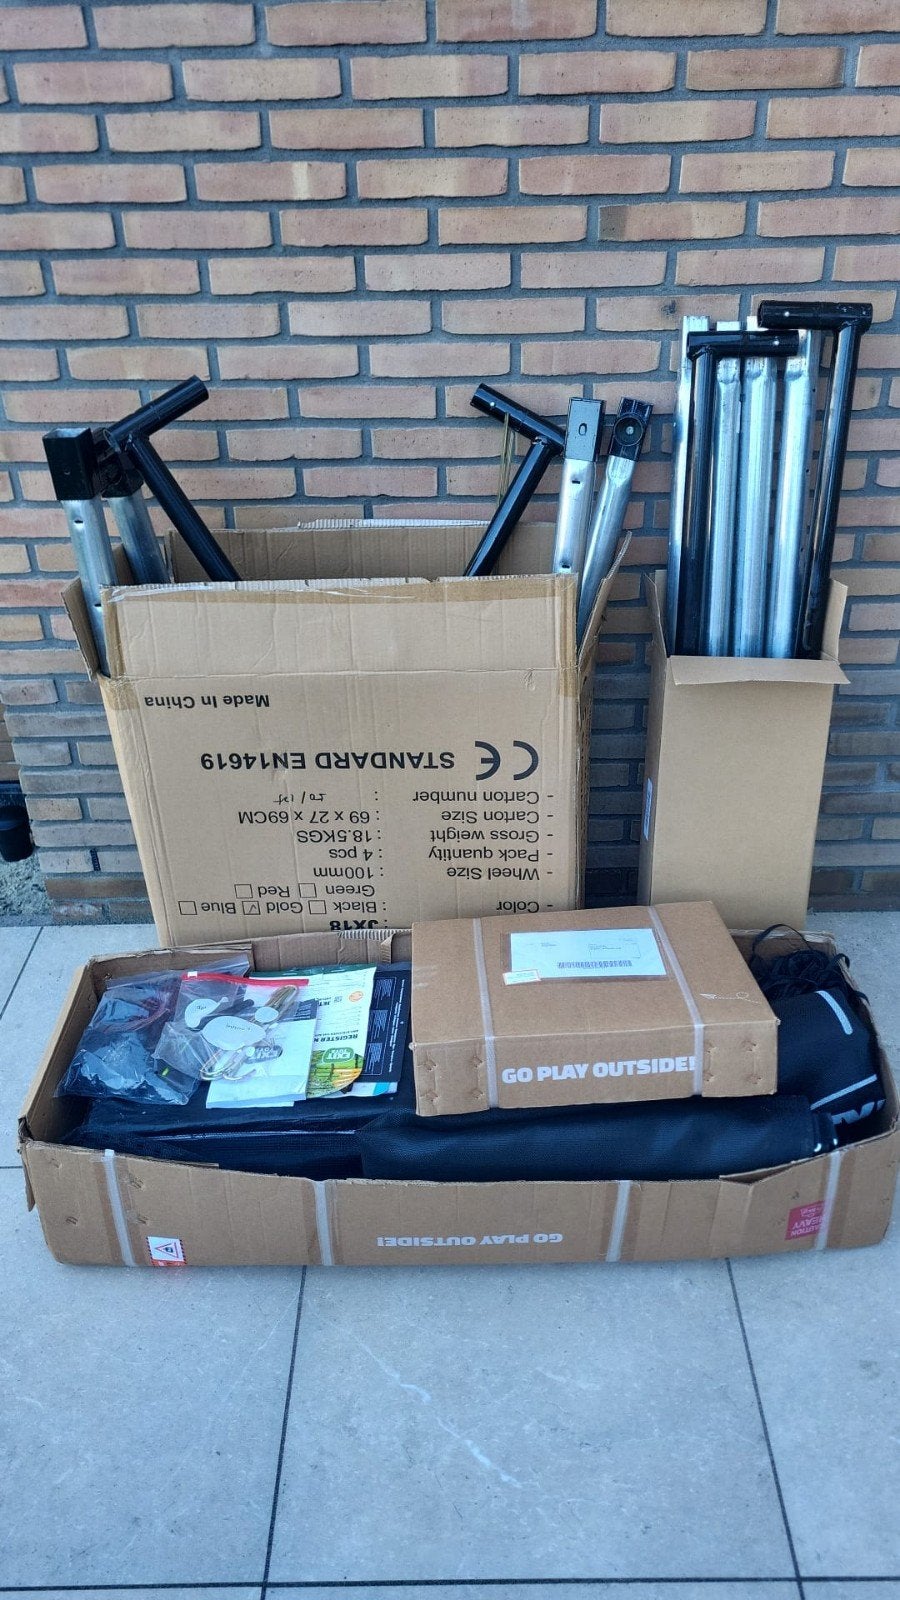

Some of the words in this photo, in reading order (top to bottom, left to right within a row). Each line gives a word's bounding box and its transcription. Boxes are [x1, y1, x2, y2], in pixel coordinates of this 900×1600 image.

[144, 696, 195, 709] China
[201, 696, 217, 708] In
[223, 694, 270, 707] Made
[201, 752, 306, 770] EN14619
[315, 752, 454, 769] STANDARD
[475, 741, 538, 781] CE
[413, 791, 476, 804] number
[483, 792, 539, 804] Carton
[239, 811, 288, 824] 69CM
[294, 811, 303, 820] x
[310, 811, 329, 823] 27
[335, 811, 343, 820] x
[350, 811, 369, 823] 69
[442, 811, 477, 823] Size
[484, 811, 539, 824] Carton
[297, 830, 372, 843] 18.5KGS
[430, 827, 485, 842] weight
[490, 830, 539, 843] Gross
[329, 846, 357, 858] pcs
[363, 849, 373, 861] 4
[429, 846, 493, 861] quantity
[498, 850, 538, 862] Pack
[314, 867, 373, 879] 100mm
[447, 868, 482, 879] Size
[488, 868, 539, 880] Wheel
[258, 886, 290, 898] Red
[326, 885, 375, 897] Green
[201, 902, 236, 914] Blue
[266, 902, 303, 913] Gold
[333, 902, 376, 913] Black
[496, 901, 540, 913] Color
[330, 920, 379, 931] JX18
[502, 1067, 534, 1084] GO
[537, 1064, 589, 1082] PLAY
[593, 1056, 696, 1078] OUTSIDE!
[791, 1225, 819, 1236] AUTION
[377, 1236, 476, 1247] OUTSIDE!
[479, 1234, 529, 1244] PLAY
[533, 1233, 563, 1243] GO
